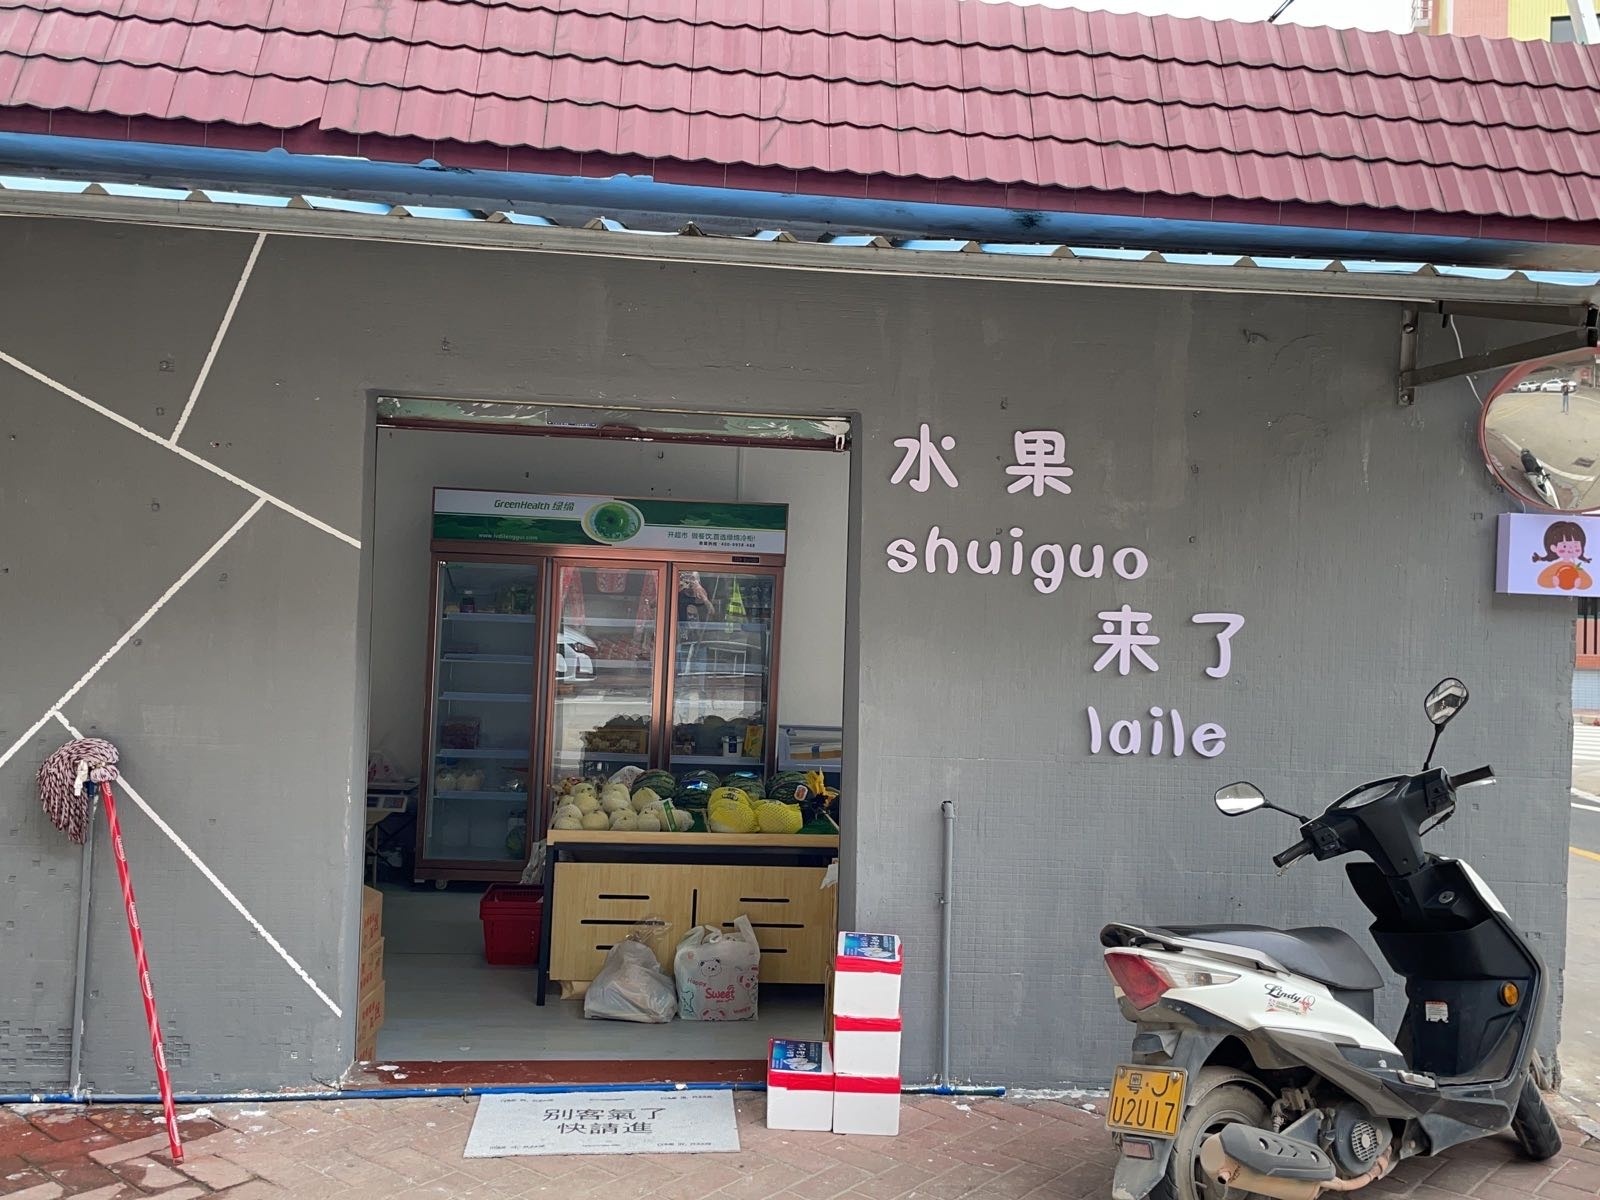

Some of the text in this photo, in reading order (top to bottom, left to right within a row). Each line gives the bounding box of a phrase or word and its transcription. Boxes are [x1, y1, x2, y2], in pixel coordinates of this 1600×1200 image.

[890, 423, 1074, 497] 水果
[494, 499, 550, 510] GreenHealth
[887, 526, 1149, 594] shuiguo
[1092, 604, 1245, 678] 来了
[1088, 706, 1227, 757] laile
[1264, 983, 1301, 1003] Lindy
[557, 1121, 653, 1135] 快請進
[1112, 1096, 1176, 1131] U2U17
